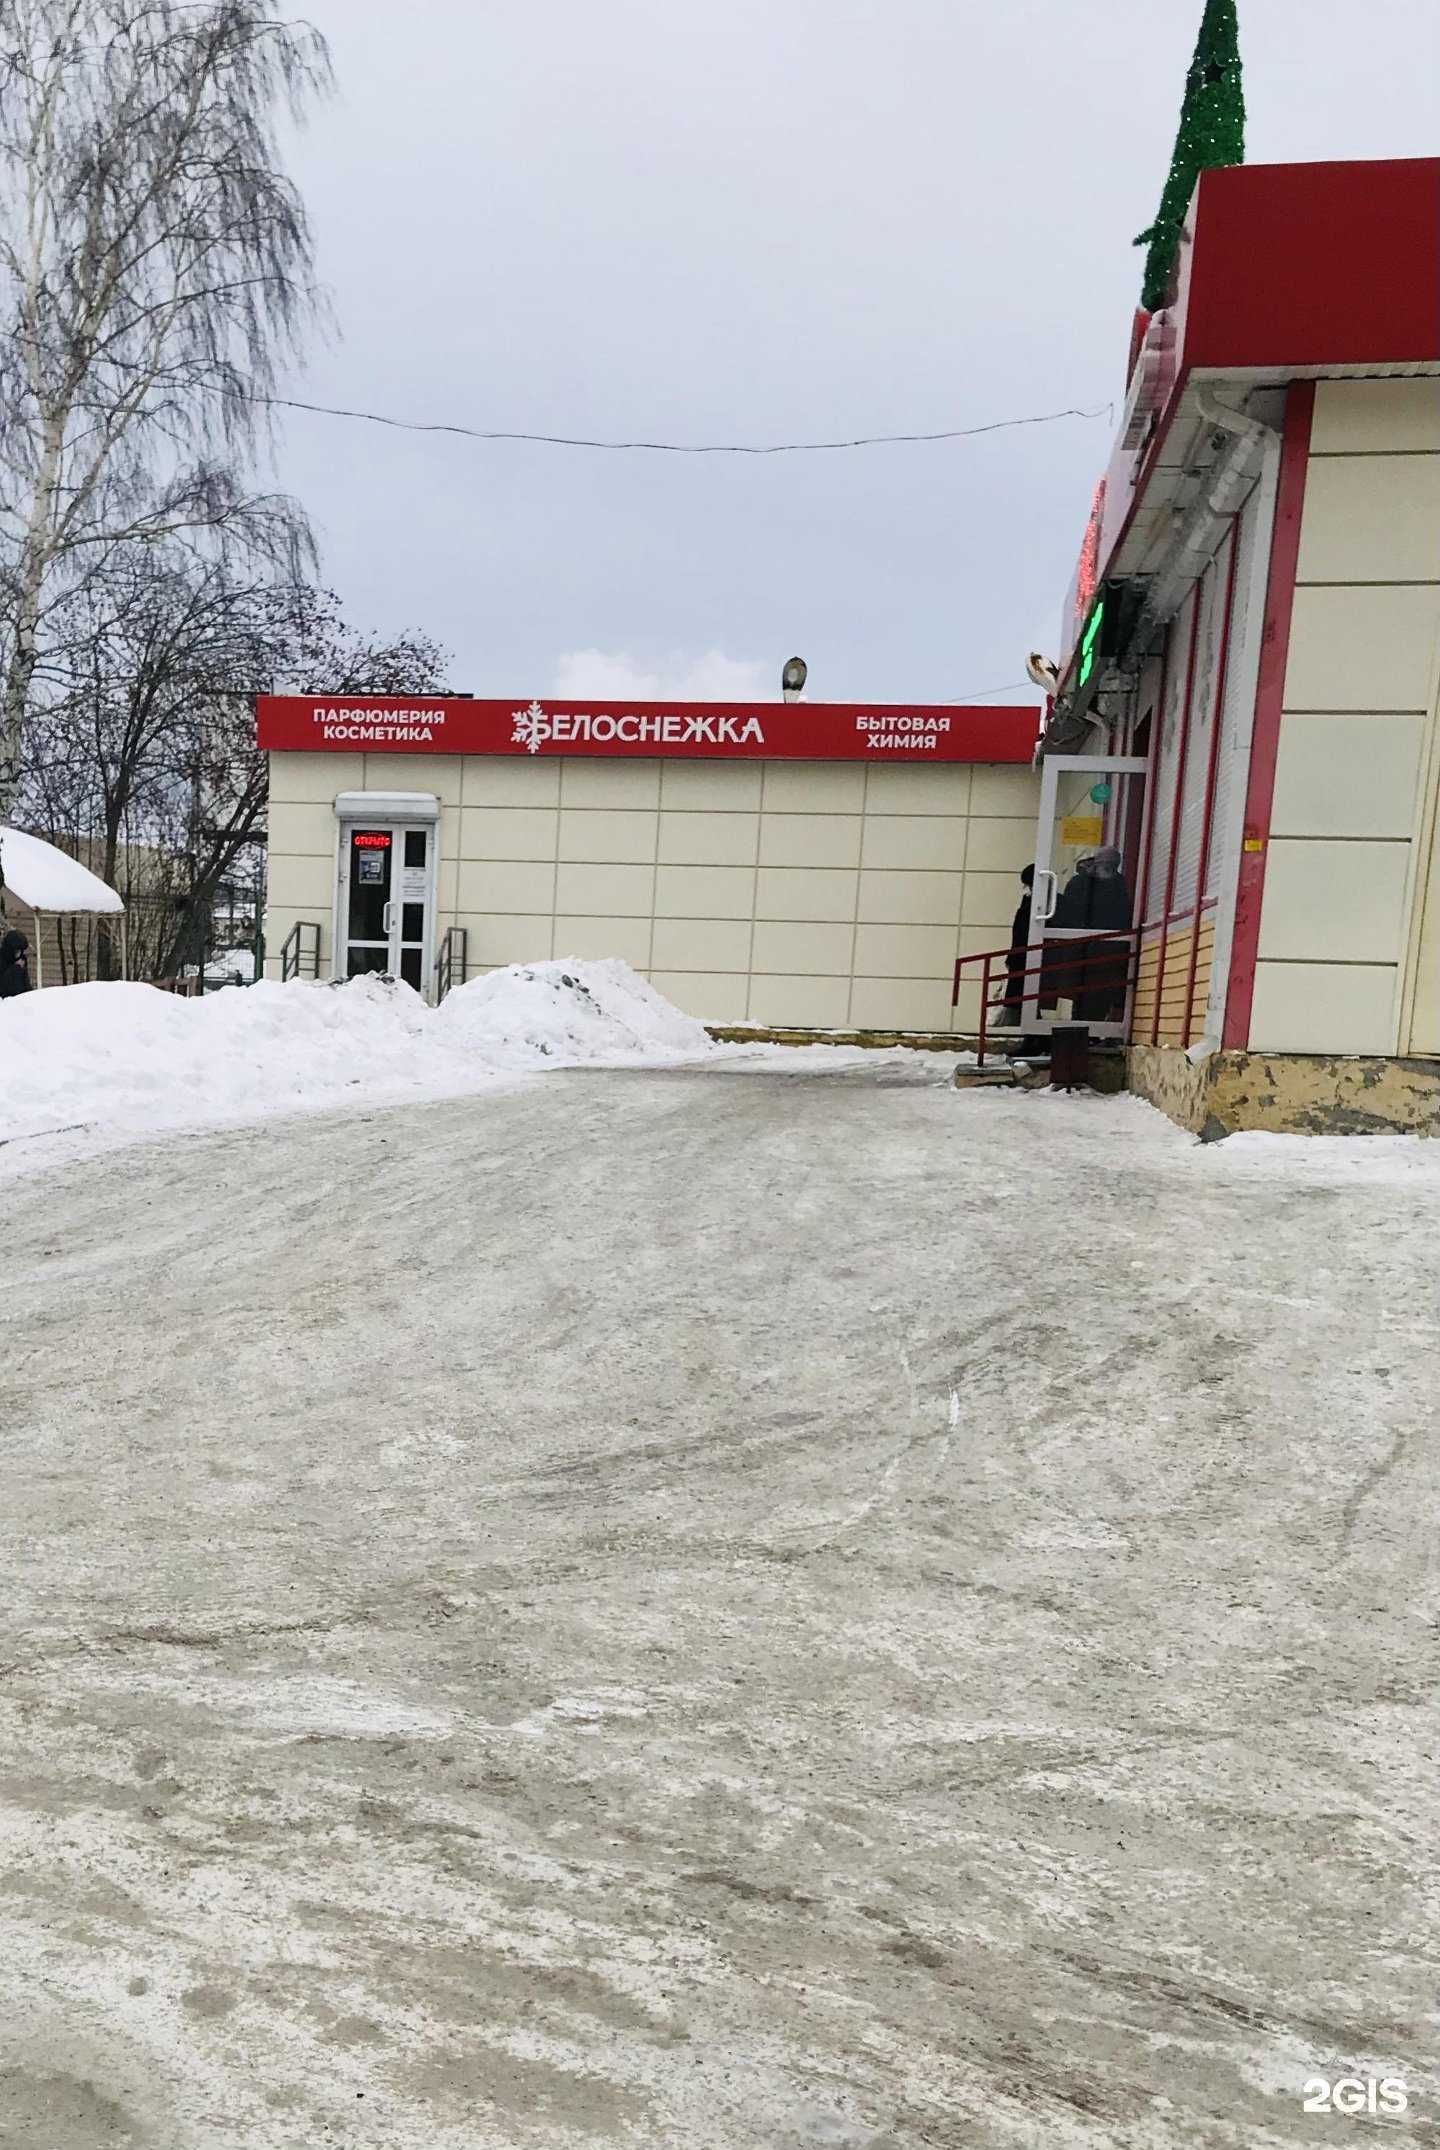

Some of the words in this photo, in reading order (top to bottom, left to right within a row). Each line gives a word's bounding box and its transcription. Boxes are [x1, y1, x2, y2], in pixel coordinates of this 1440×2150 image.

[313, 708, 445, 724] ПАРФЮМЕРИЯ
[856, 716, 950, 732] БЫТОВАЯ
[323, 725, 433, 741] КОСМЕТИКА
[530, 713, 765, 744] БЕЛОСНЕЖКА
[866, 734, 937, 749] ХИМИЯ
